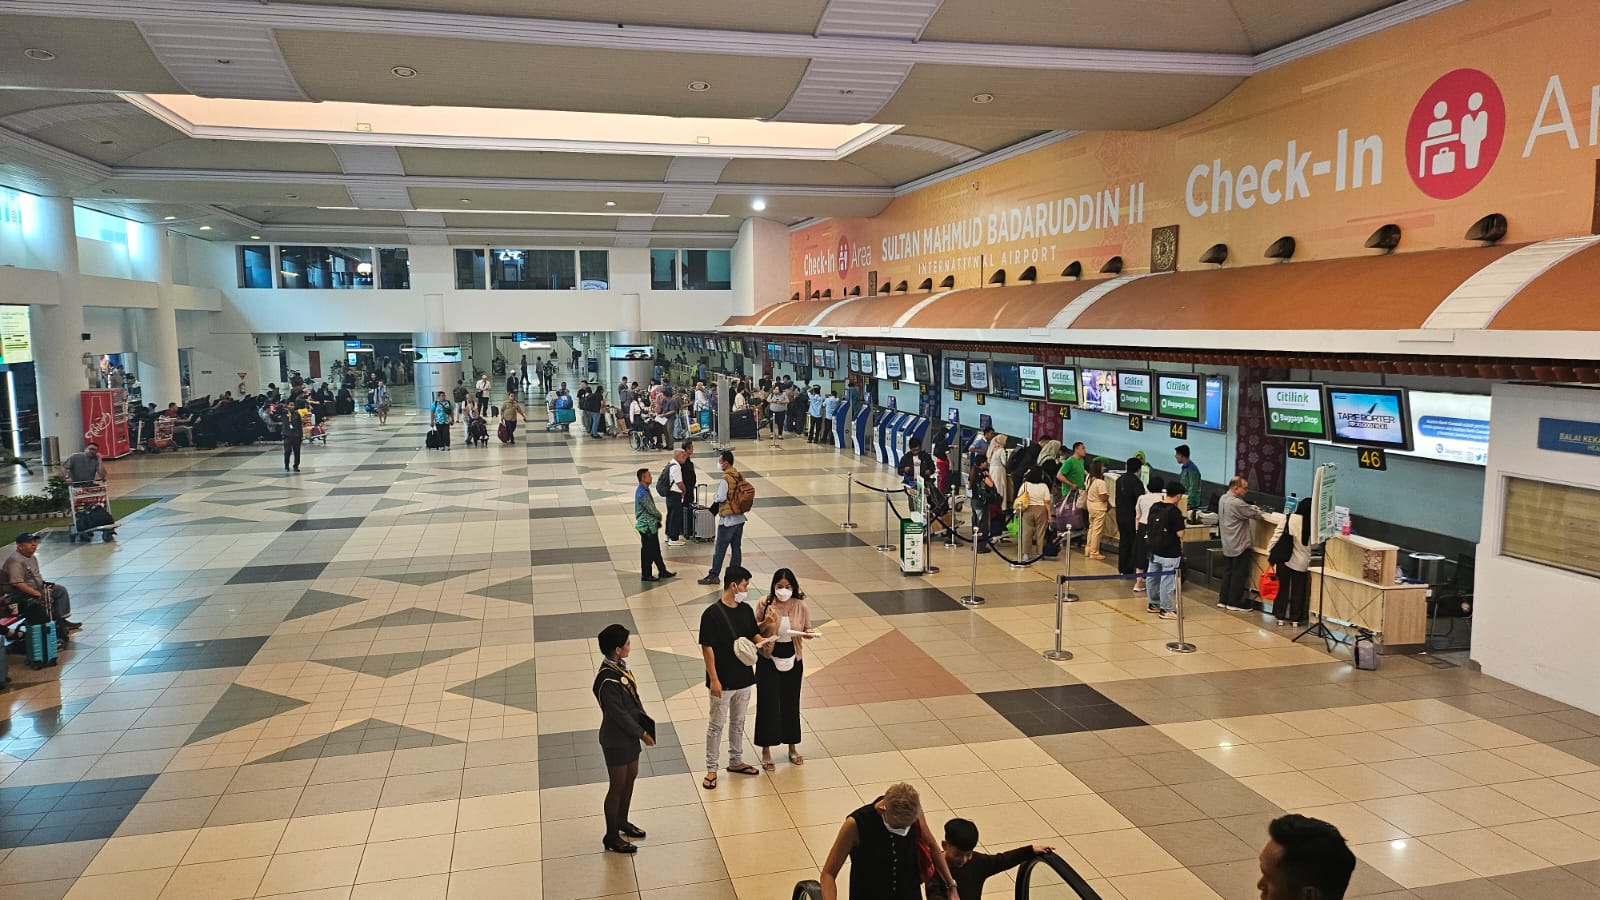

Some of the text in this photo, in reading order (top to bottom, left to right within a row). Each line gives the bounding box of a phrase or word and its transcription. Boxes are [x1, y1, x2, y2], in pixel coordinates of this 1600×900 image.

[1186, 128, 1384, 217] Check-In
[881, 182, 1145, 262] SULTAN MAHMUD BADARUDDIN II
[803, 241, 872, 276] Check-In Area
[1001, 245, 1057, 265] AIRPORT
[1166, 380, 1190, 391] Citilink
[1277, 391, 1309, 403] Citilink
[1030, 401, 1037, 412] 41
[1059, 406, 1068, 418] 42
[1129, 416, 1140, 429] 43
[1280, 413, 1319, 424] Baggage Drop
[1171, 423, 1184, 437] 44
[1559, 432, 1581, 442] BALAI
[1289, 441, 1305, 457] 45
[1361, 451, 1380, 467] 46
